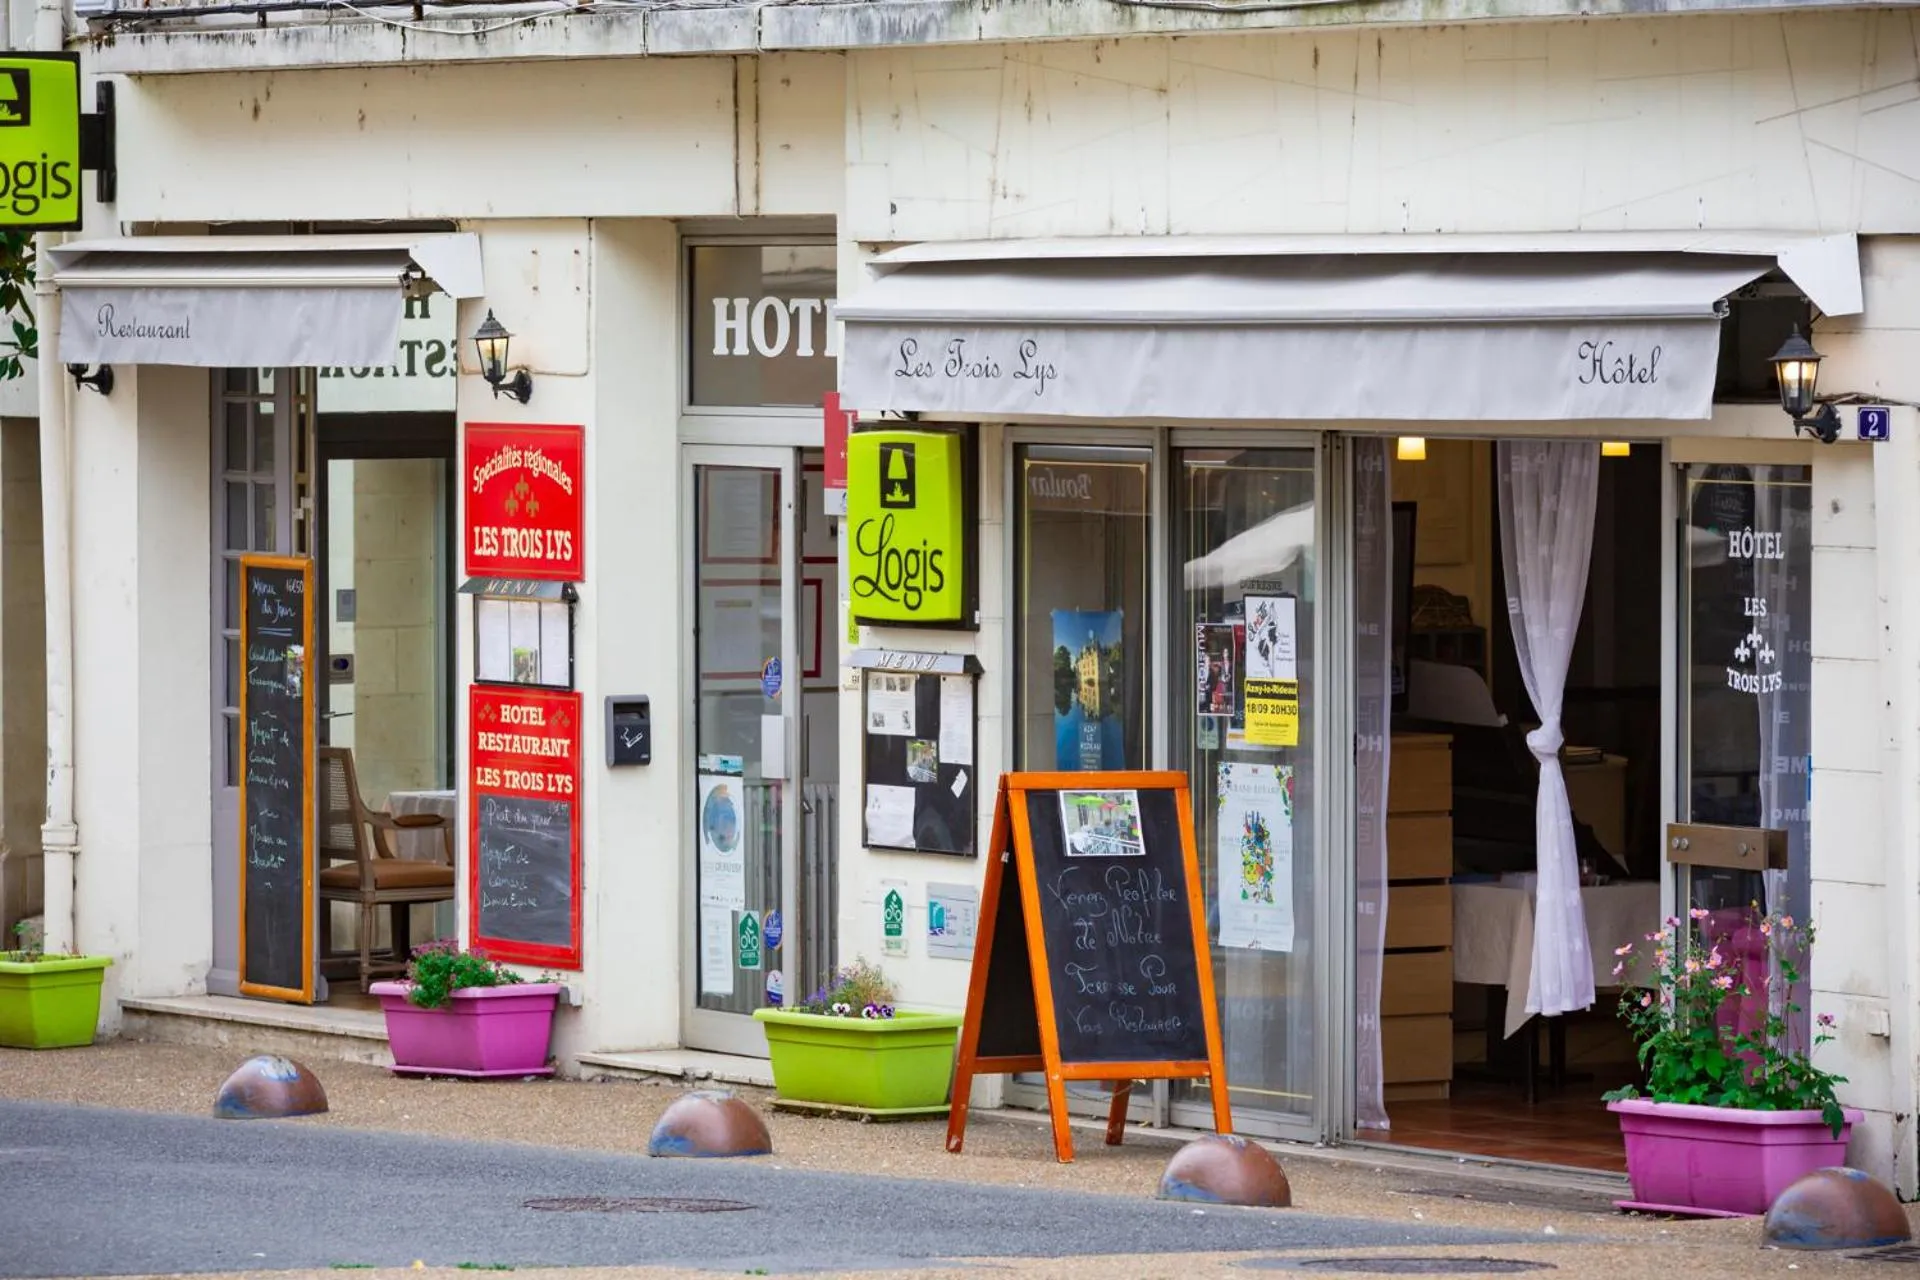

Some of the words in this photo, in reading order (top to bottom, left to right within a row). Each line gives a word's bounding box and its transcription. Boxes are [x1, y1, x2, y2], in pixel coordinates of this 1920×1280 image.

[98, 303, 191, 340] Restaurant
[895, 337, 934, 378] Les
[945, 338, 1002, 378] Trois
[1013, 339, 1057, 396] Lys
[1578, 341, 1662, 386] Hôtel
[1867, 412, 1880, 437] 2
[472, 444, 523, 494] Spécialités
[523, 444, 573, 496] régionales
[473, 526, 499, 557] LES
[501, 526, 543, 559] TROIS
[546, 529, 573, 561] LYS
[1728, 526, 1785, 559] HÔTEL
[853, 513, 944, 611] Logis
[485, 580, 541, 595] MENU
[1744, 597, 1767, 617] LES
[877, 653, 939, 670] MENU
[1726, 667, 1760, 693] TROIS
[1762, 671, 1782, 693] LYS
[500, 704, 546, 726] HOTEL
[478, 731, 571, 758] RESTAURANT
[476, 767, 501, 787] LES
[503, 769, 544, 792] TROIS
[547, 773, 573, 794] LYS
